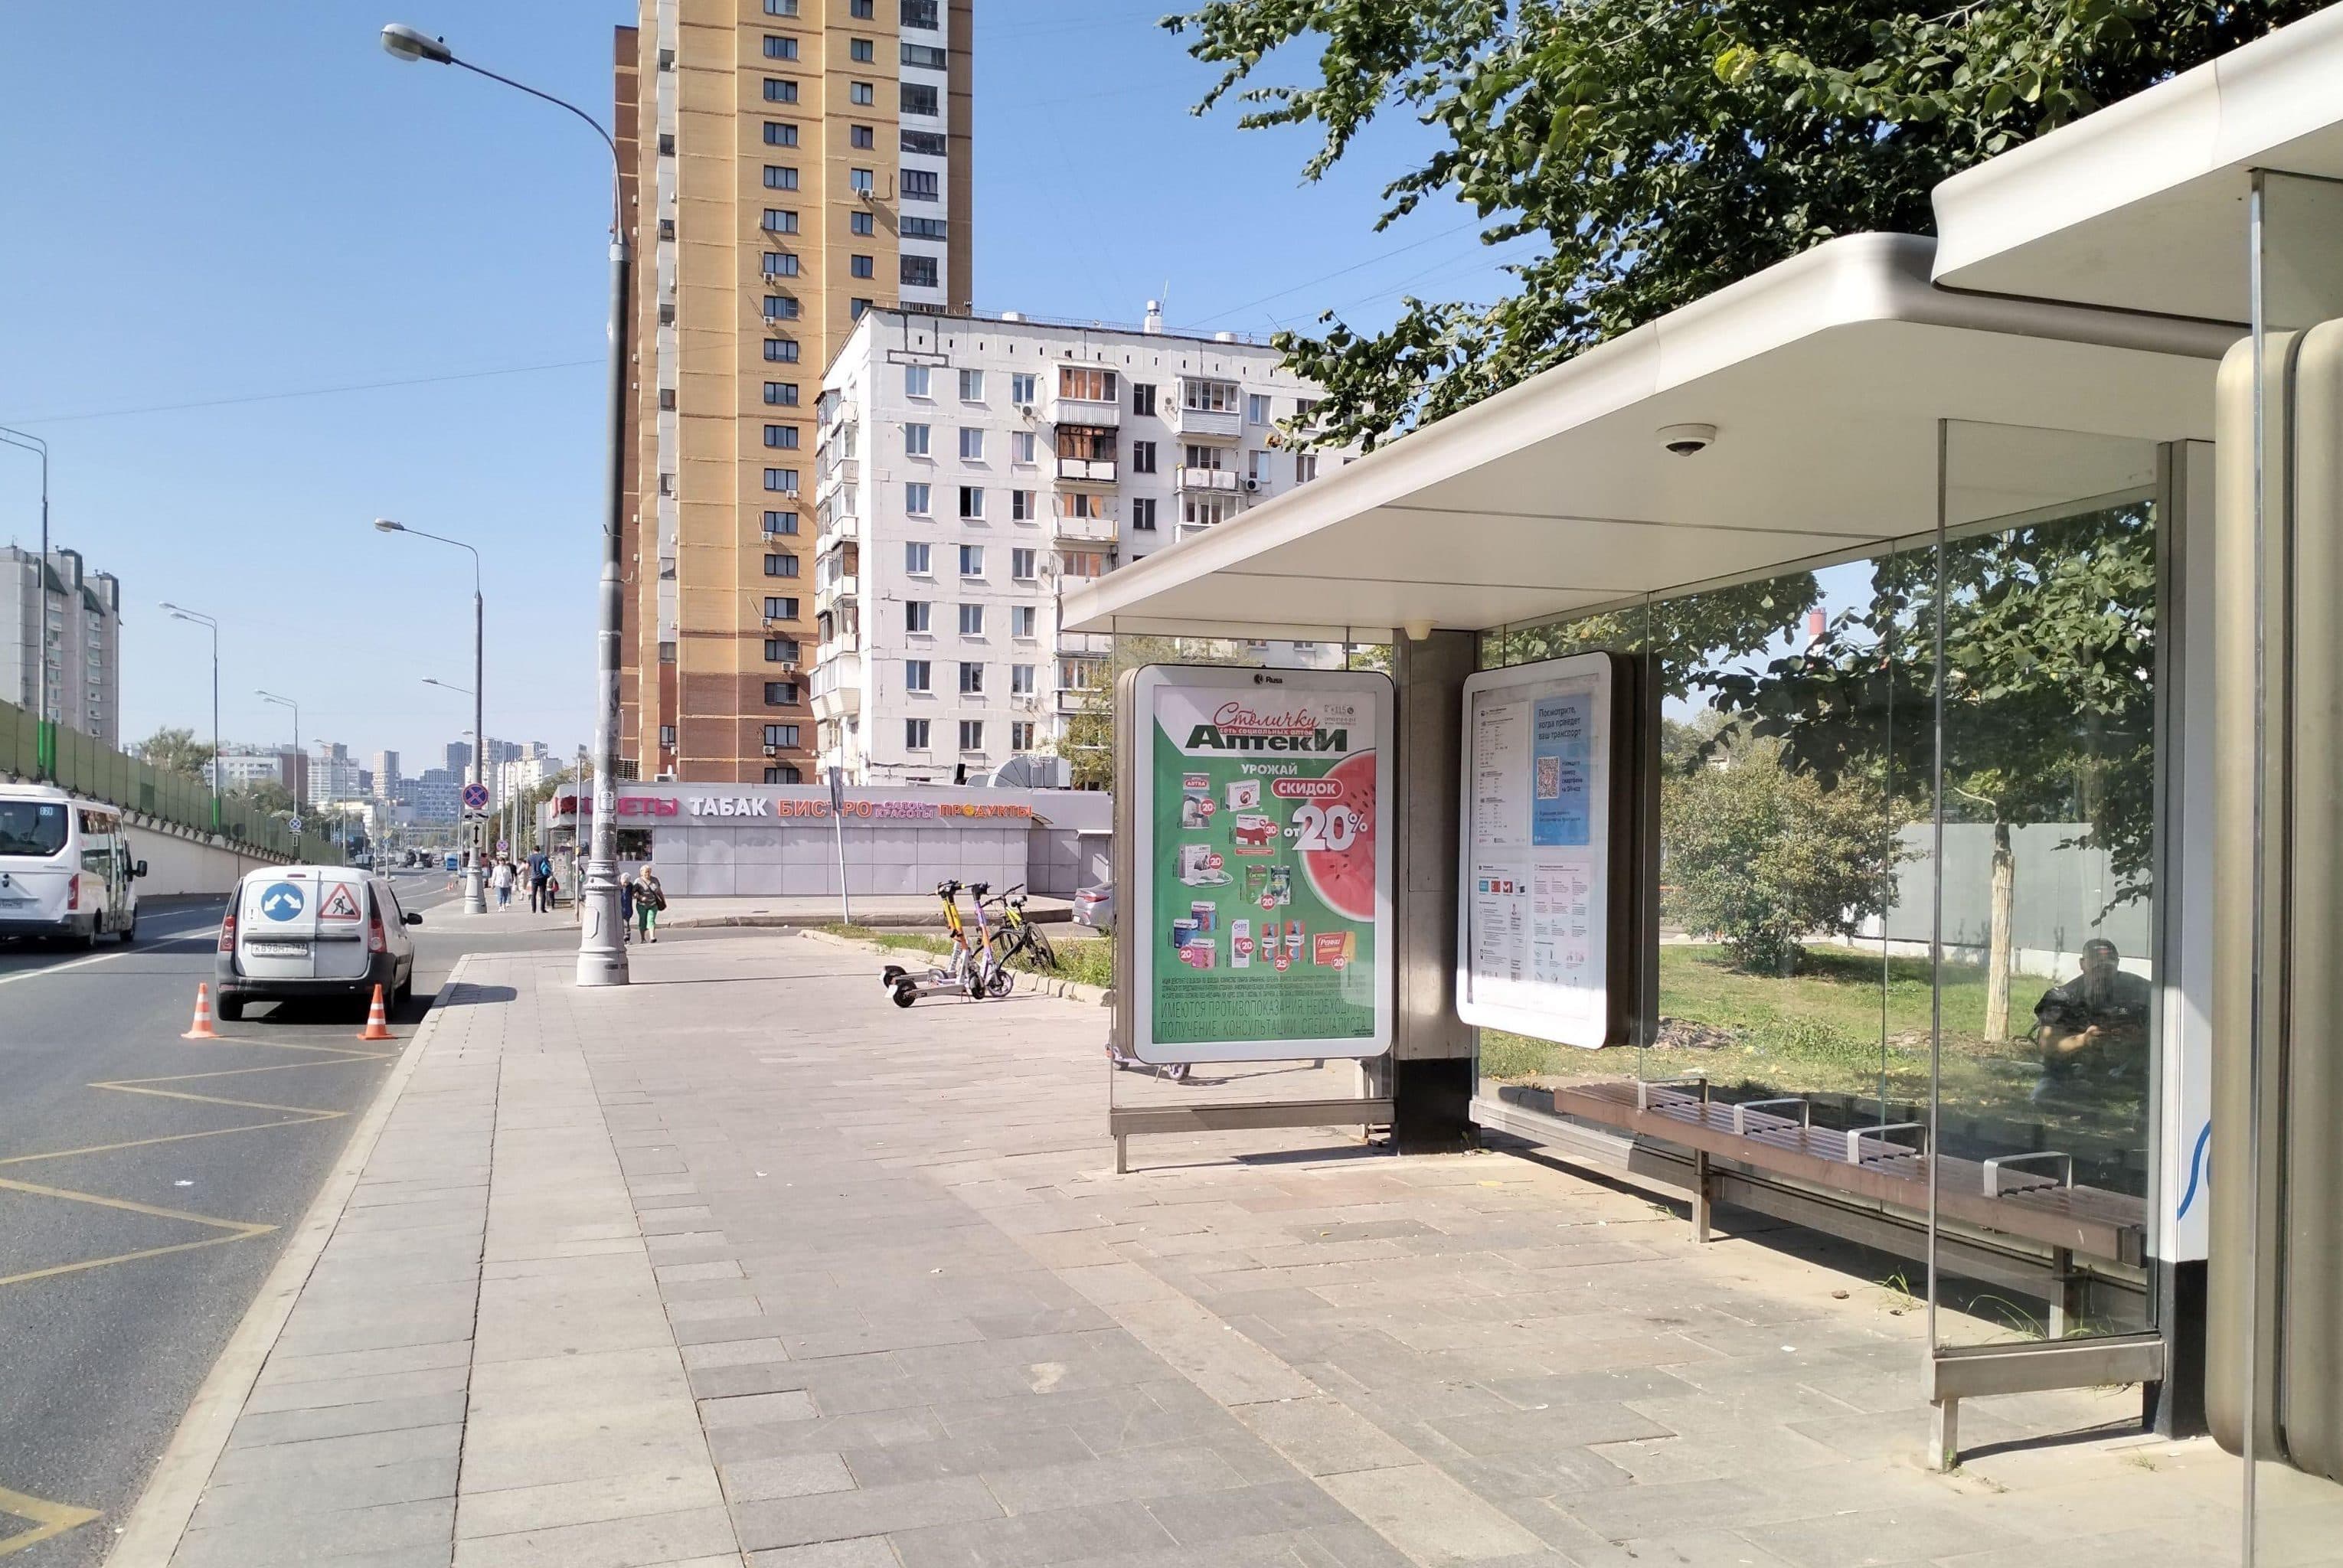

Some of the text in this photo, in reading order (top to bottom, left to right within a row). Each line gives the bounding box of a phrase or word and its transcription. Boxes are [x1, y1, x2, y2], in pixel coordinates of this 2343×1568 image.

[1214, 702, 1321, 727] Столички
[1240, 762, 1298, 775] УРОЖАЙ
[1278, 782, 1336, 795] СКИДОК
[690, 797, 768, 817] ТАБАК
[875, 809, 933, 818] КРАСОТЫ
[1284, 828, 1300, 837] от
[1180, 950, 1191, 959] 20
[1276, 959, 1287, 968] 25
[1161, 1001, 1206, 1018] ИМЕЮТСЯ
[1160, 1021, 1217, 1037] ПОЛУЧЕНИЕ
[1224, 1019, 1296, 1036] КОНСУЛЬТАЦИИ
